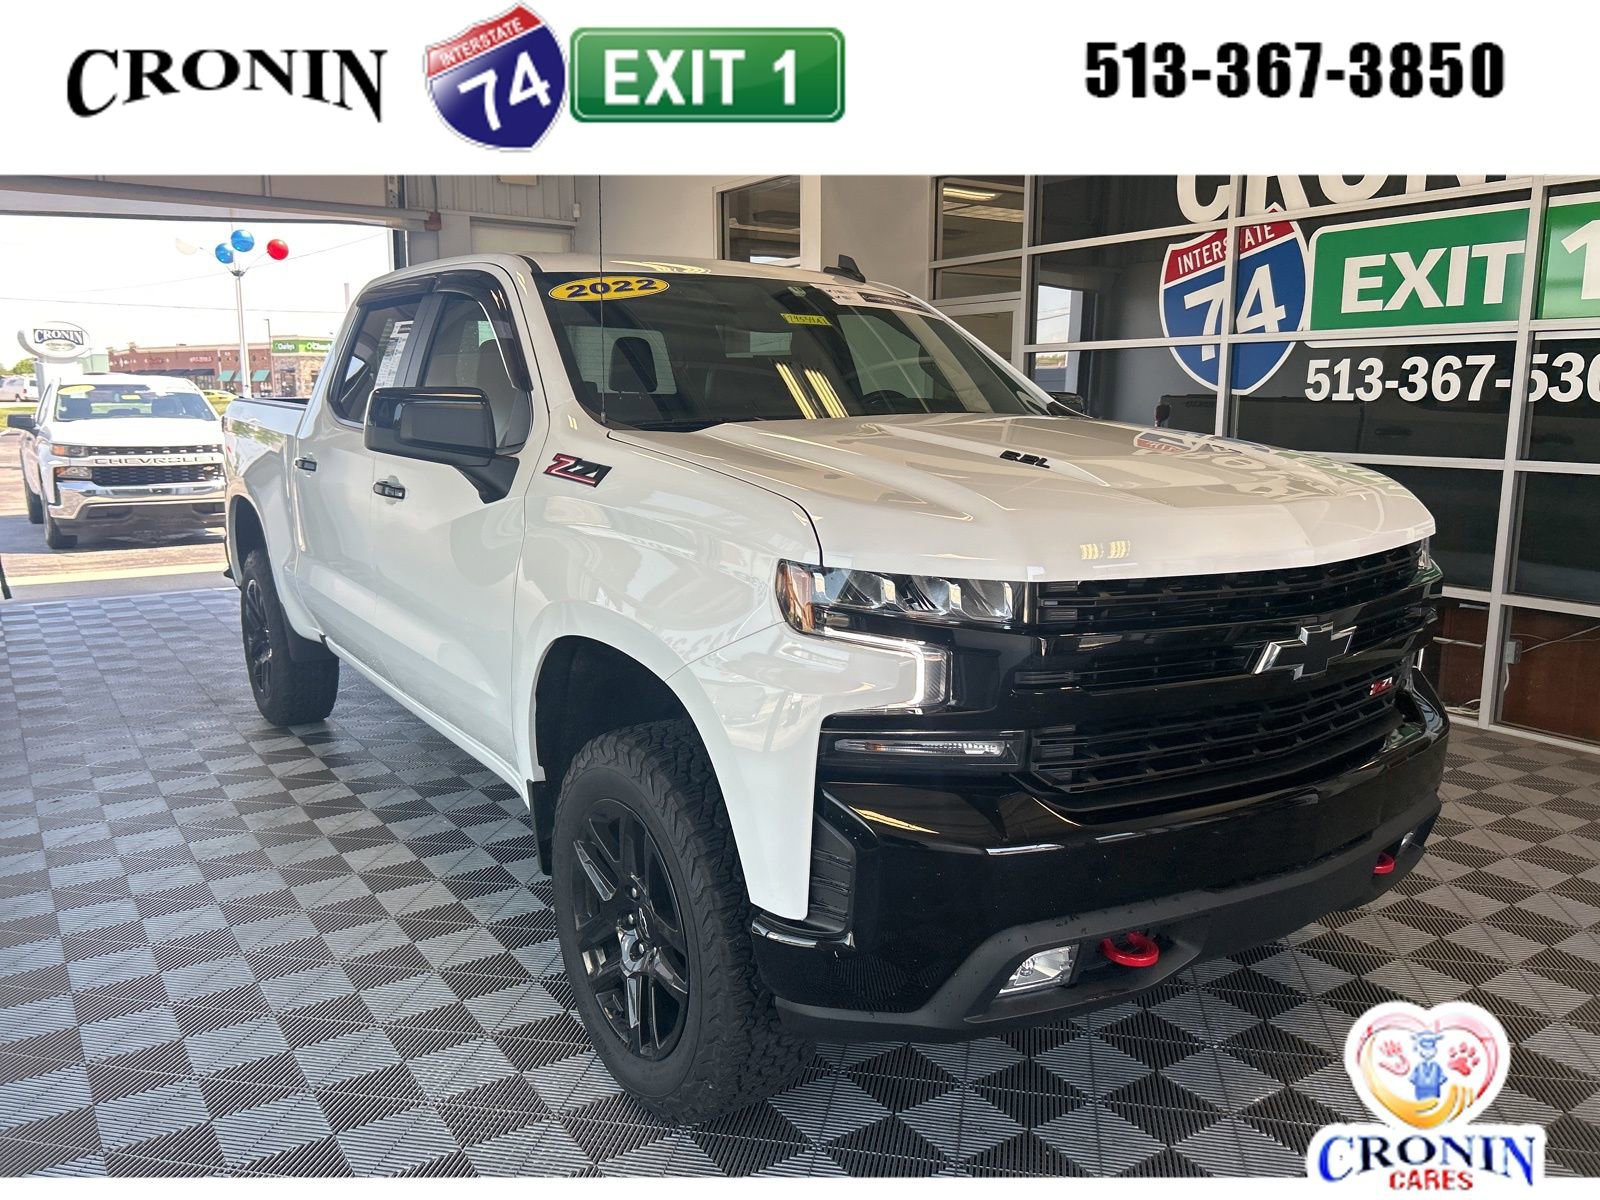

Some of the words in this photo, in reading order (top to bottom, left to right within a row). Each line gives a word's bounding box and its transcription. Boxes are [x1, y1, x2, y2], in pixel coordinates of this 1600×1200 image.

[1177, 224, 1275, 275] INTERATE
[565, 279, 657, 298] 2022
[1341, 240, 1526, 314] EXIT
[34, 329, 83, 344] CRONIN
[1184, 264, 1287, 361] 74
